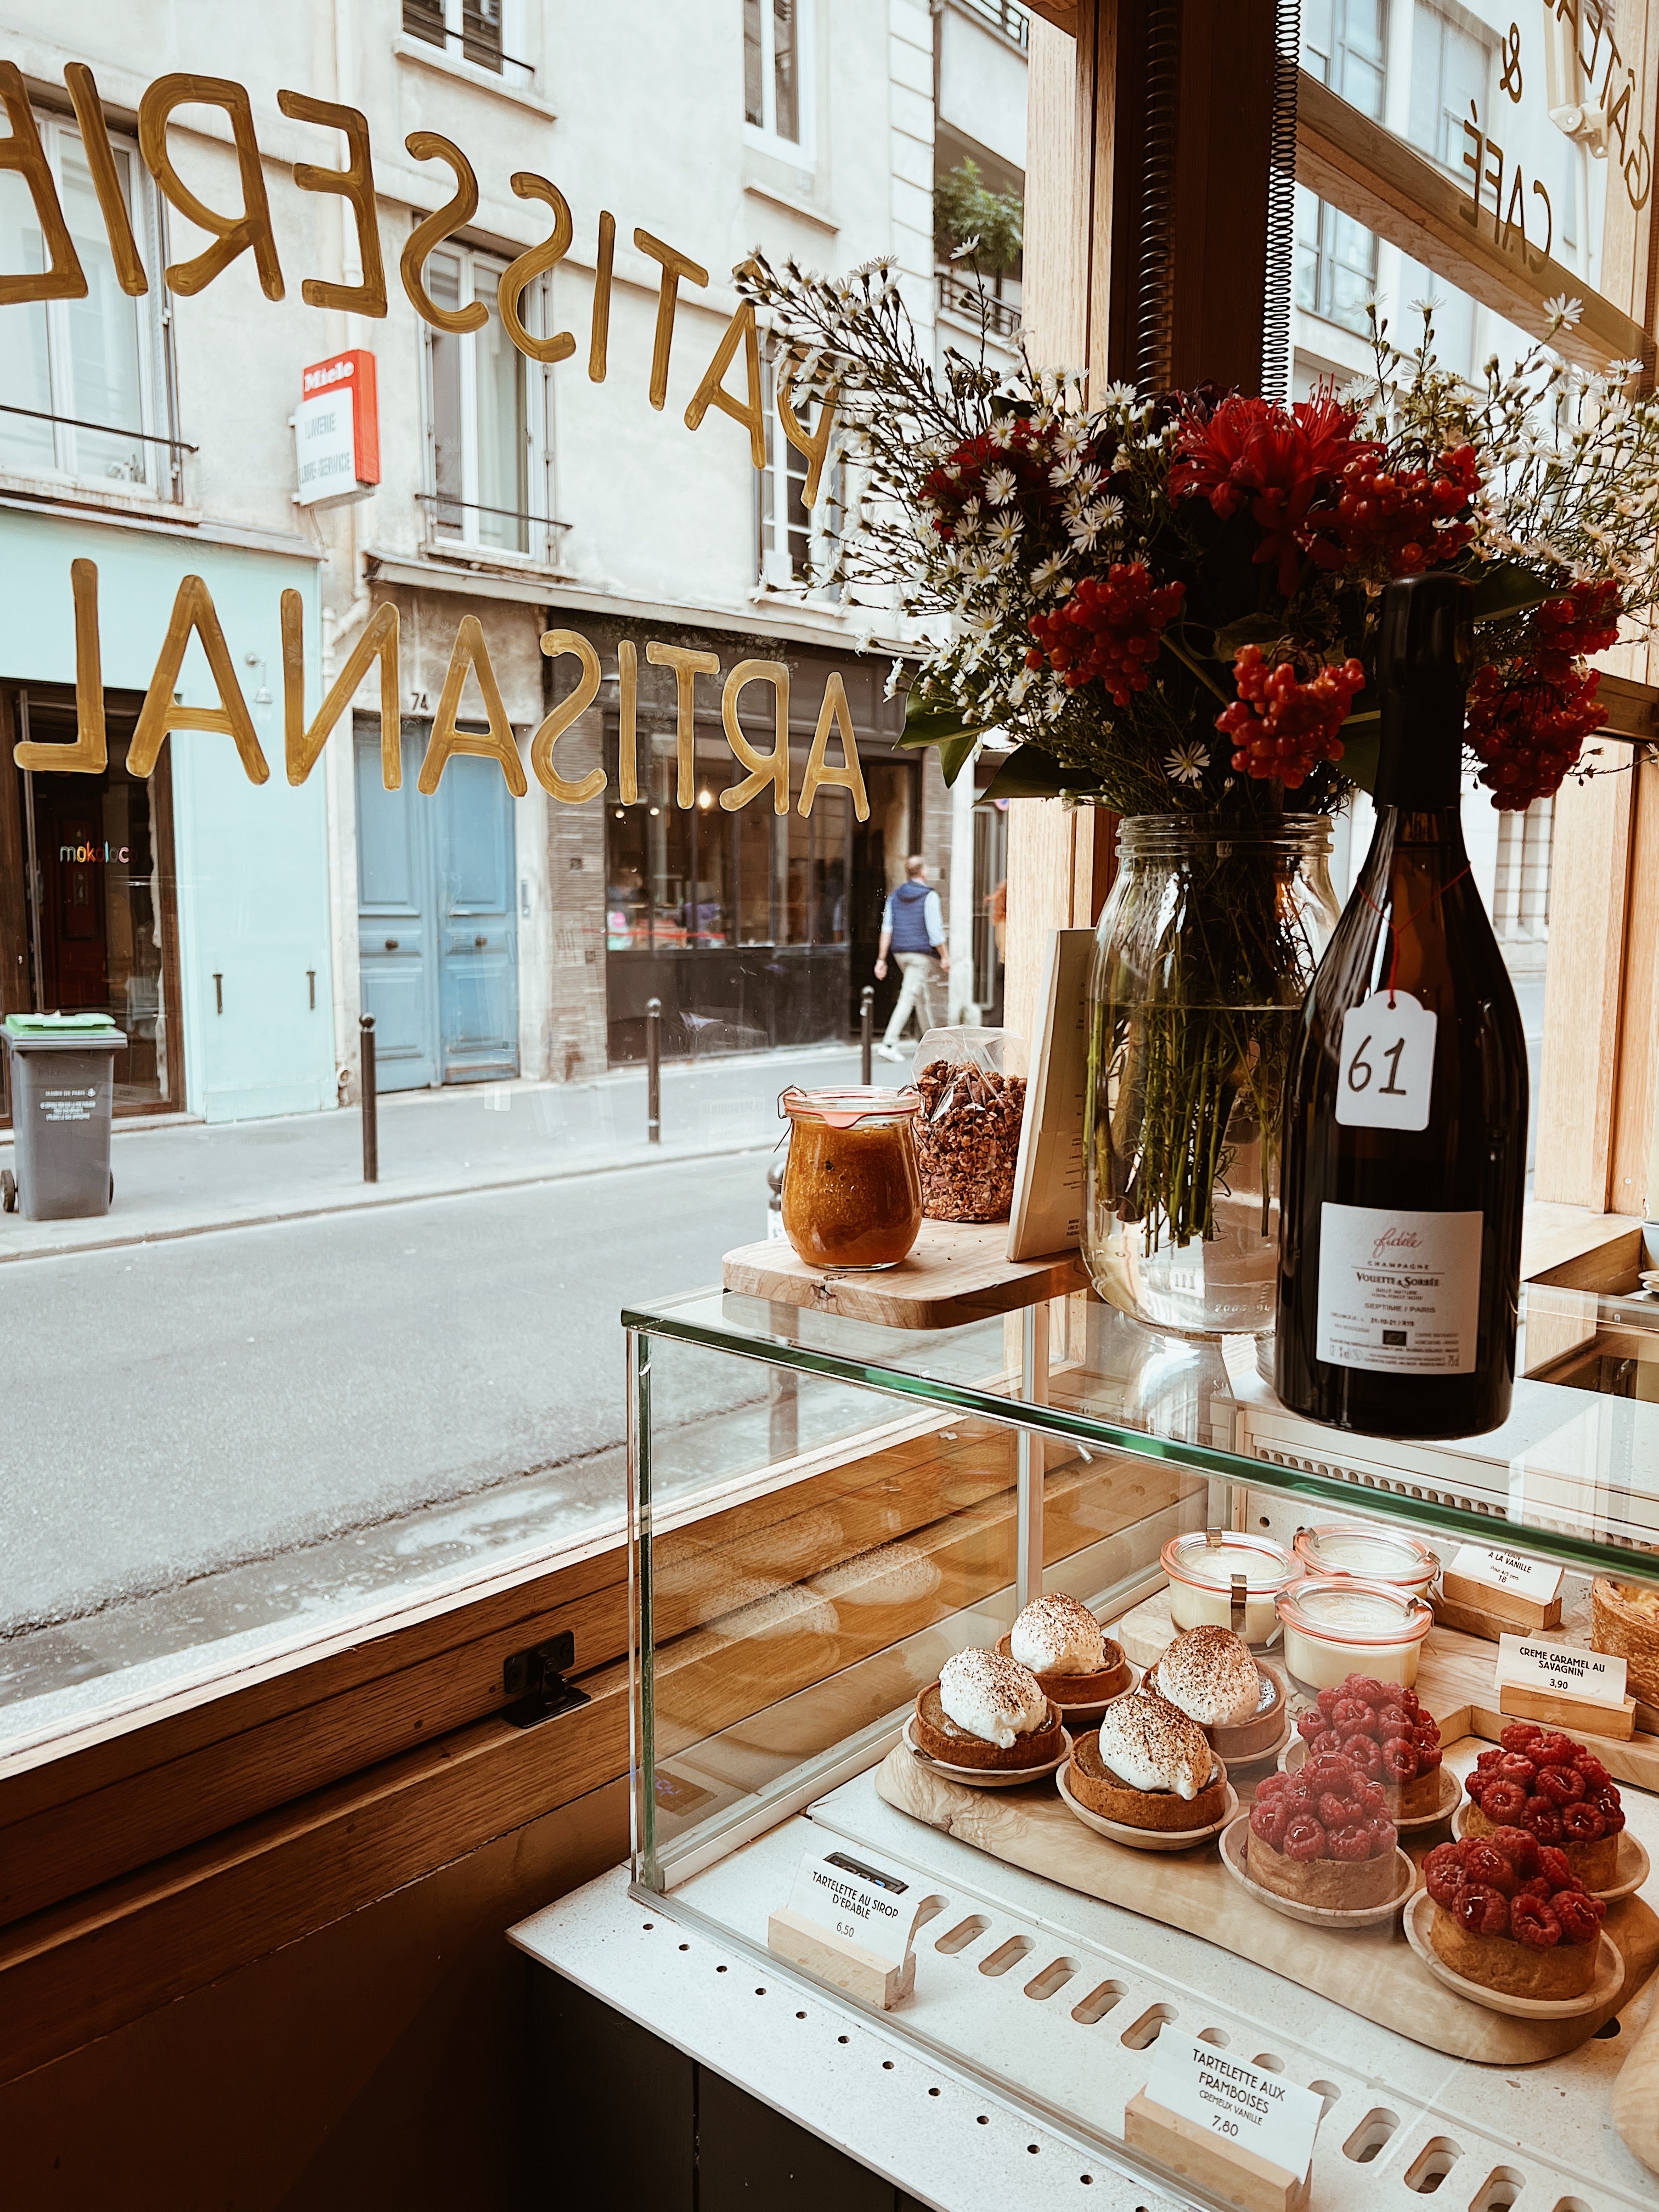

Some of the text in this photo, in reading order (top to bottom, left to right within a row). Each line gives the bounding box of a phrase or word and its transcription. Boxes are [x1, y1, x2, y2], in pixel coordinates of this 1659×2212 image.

[304, 360, 354, 392] Miele
[411, 692, 428, 710] 74
[1346, 1035, 1408, 1097] 61
[1367, 1261, 1430, 1270] CHAMPAGNE
[1364, 1302, 1402, 1312] SEPTIME
[1495, 1554, 1503, 1562] LA
[1505, 1557, 1532, 1573] VANILLE
[1519, 1647, 1605, 1673] CREME CARAMEL AU
[1538, 1660, 1584, 1678] SAVAGNIN
[1549, 1678, 1568, 1689] 3,90
[812, 1871, 859, 1901] TARTELETTE
[859, 1893, 872, 1907] AU
[872, 1900, 899, 1918] SIROP
[832, 1894, 871, 1919] D'ERABLE
[836, 1922, 855, 1938] 6,50
[1192, 2048, 1286, 2102] TARTELETTE AUX
[1199, 2071, 1270, 2114] FRAMBOISES
[1199, 2090, 1263, 2126] CREMEUX VANILLE
[1211, 2115, 1239, 2137] 7,80
